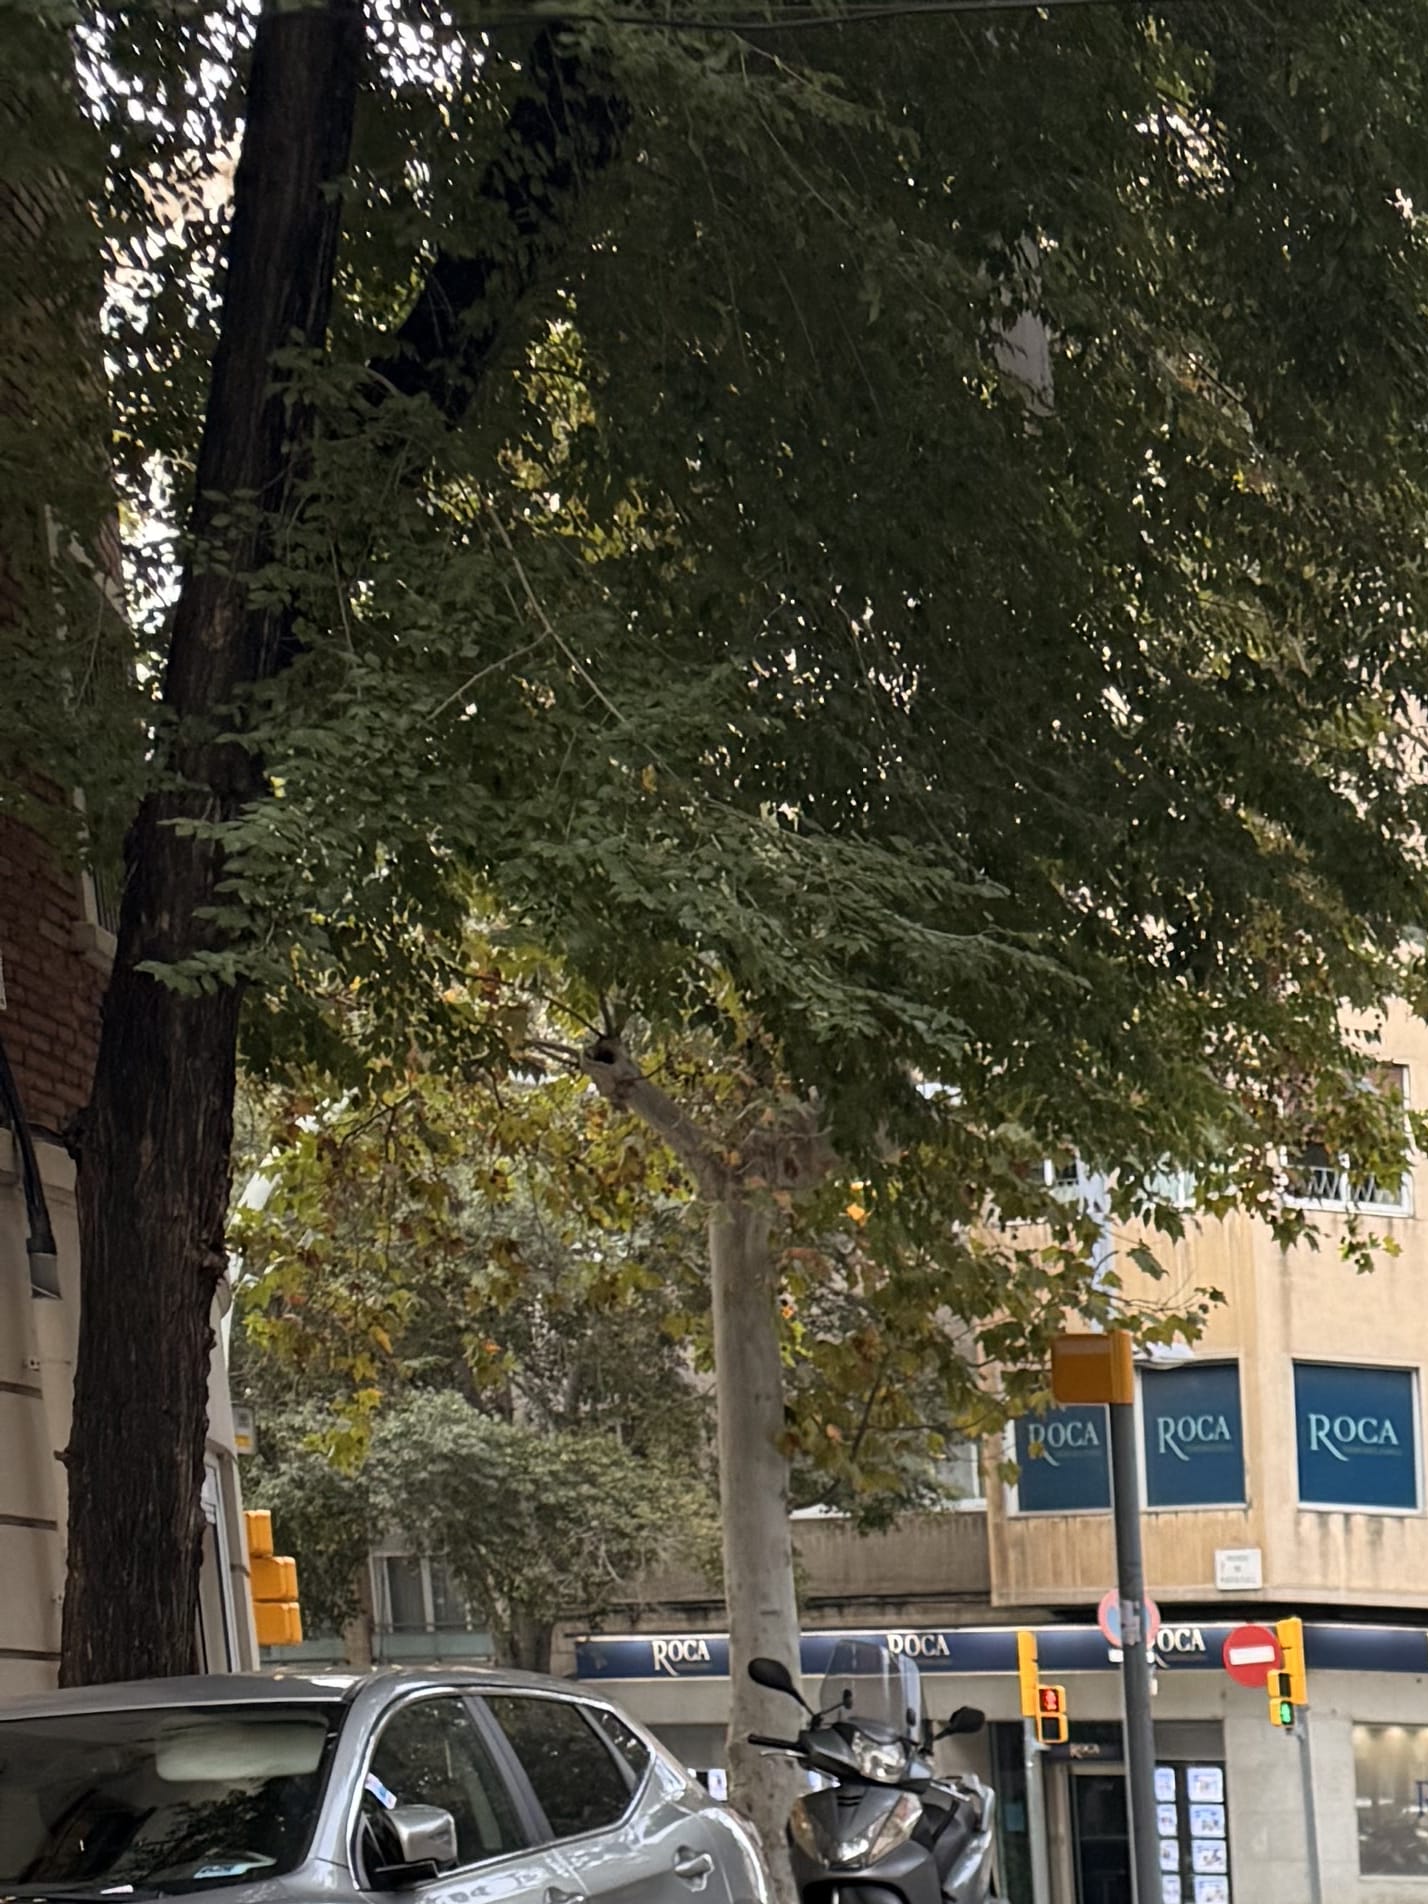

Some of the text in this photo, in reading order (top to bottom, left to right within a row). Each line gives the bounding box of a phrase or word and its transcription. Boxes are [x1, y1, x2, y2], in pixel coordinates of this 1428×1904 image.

[1028, 1421, 1099, 1467] ROCA
[1157, 1415, 1232, 1462] ROCA
[1308, 1413, 1399, 1462] ROCA
[652, 1639, 711, 1677] ROCA
